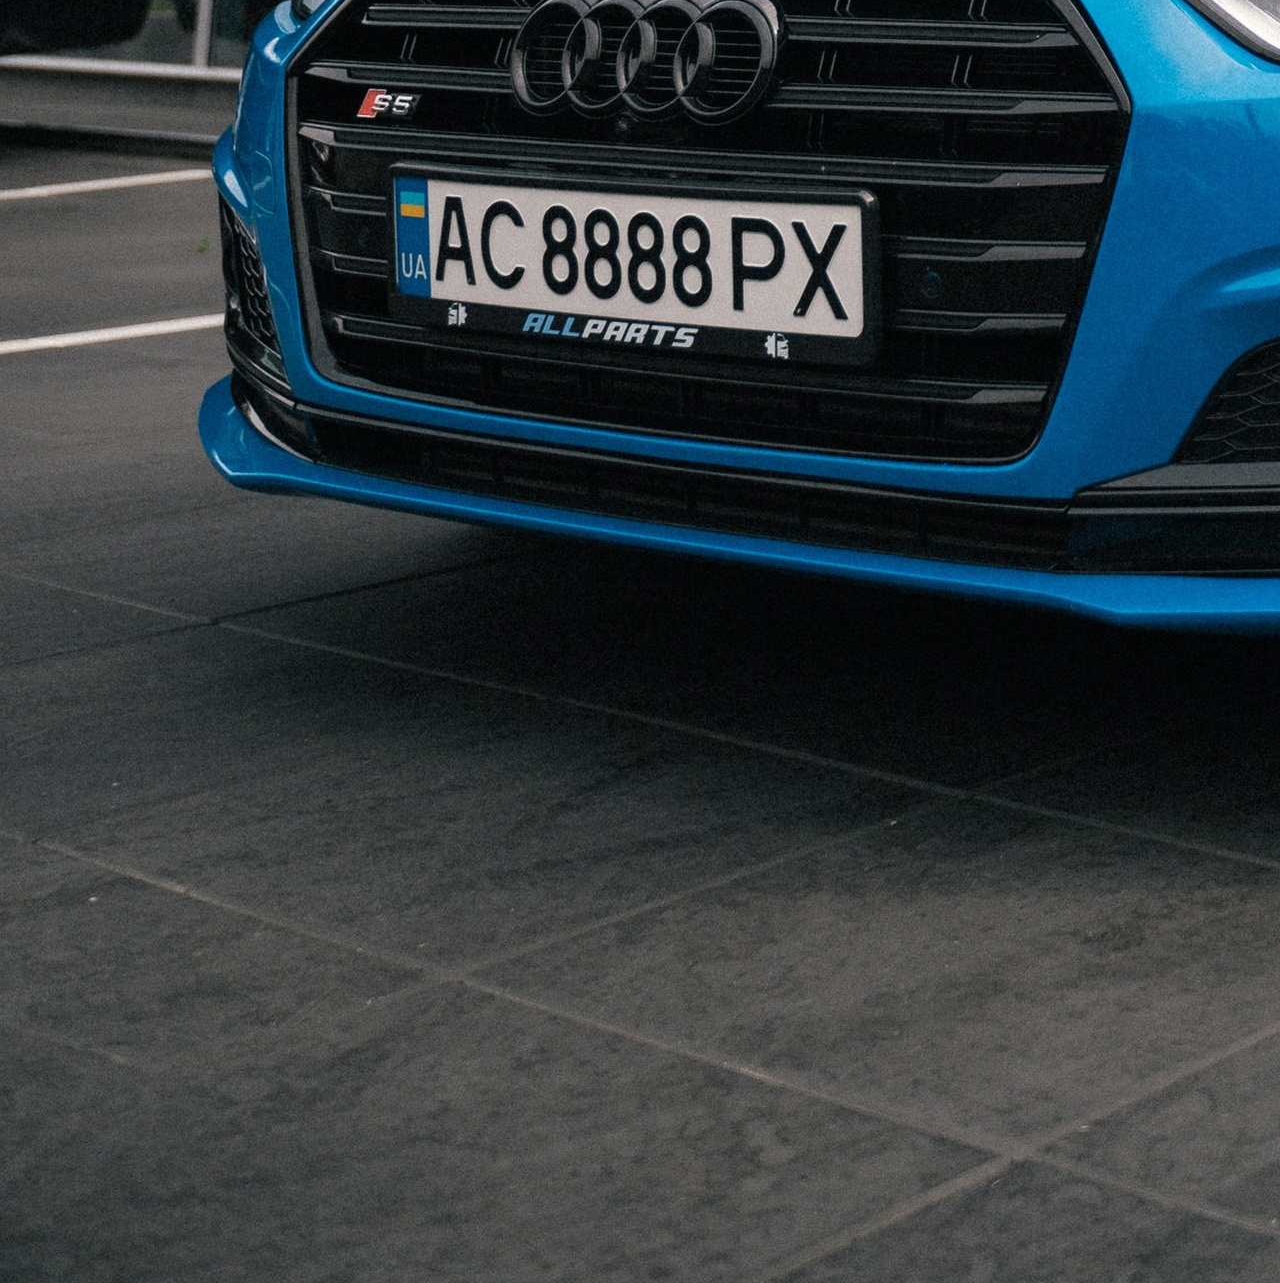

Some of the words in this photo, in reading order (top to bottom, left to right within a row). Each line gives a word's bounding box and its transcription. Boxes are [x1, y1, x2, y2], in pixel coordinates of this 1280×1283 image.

[371, 94, 413, 113] S5
[401, 252, 427, 280] UA
[435, 195, 526, 290] AC
[542, 204, 713, 308] 8888
[731, 216, 848, 320] PX
[522, 312, 699, 348] ALLPARTS
